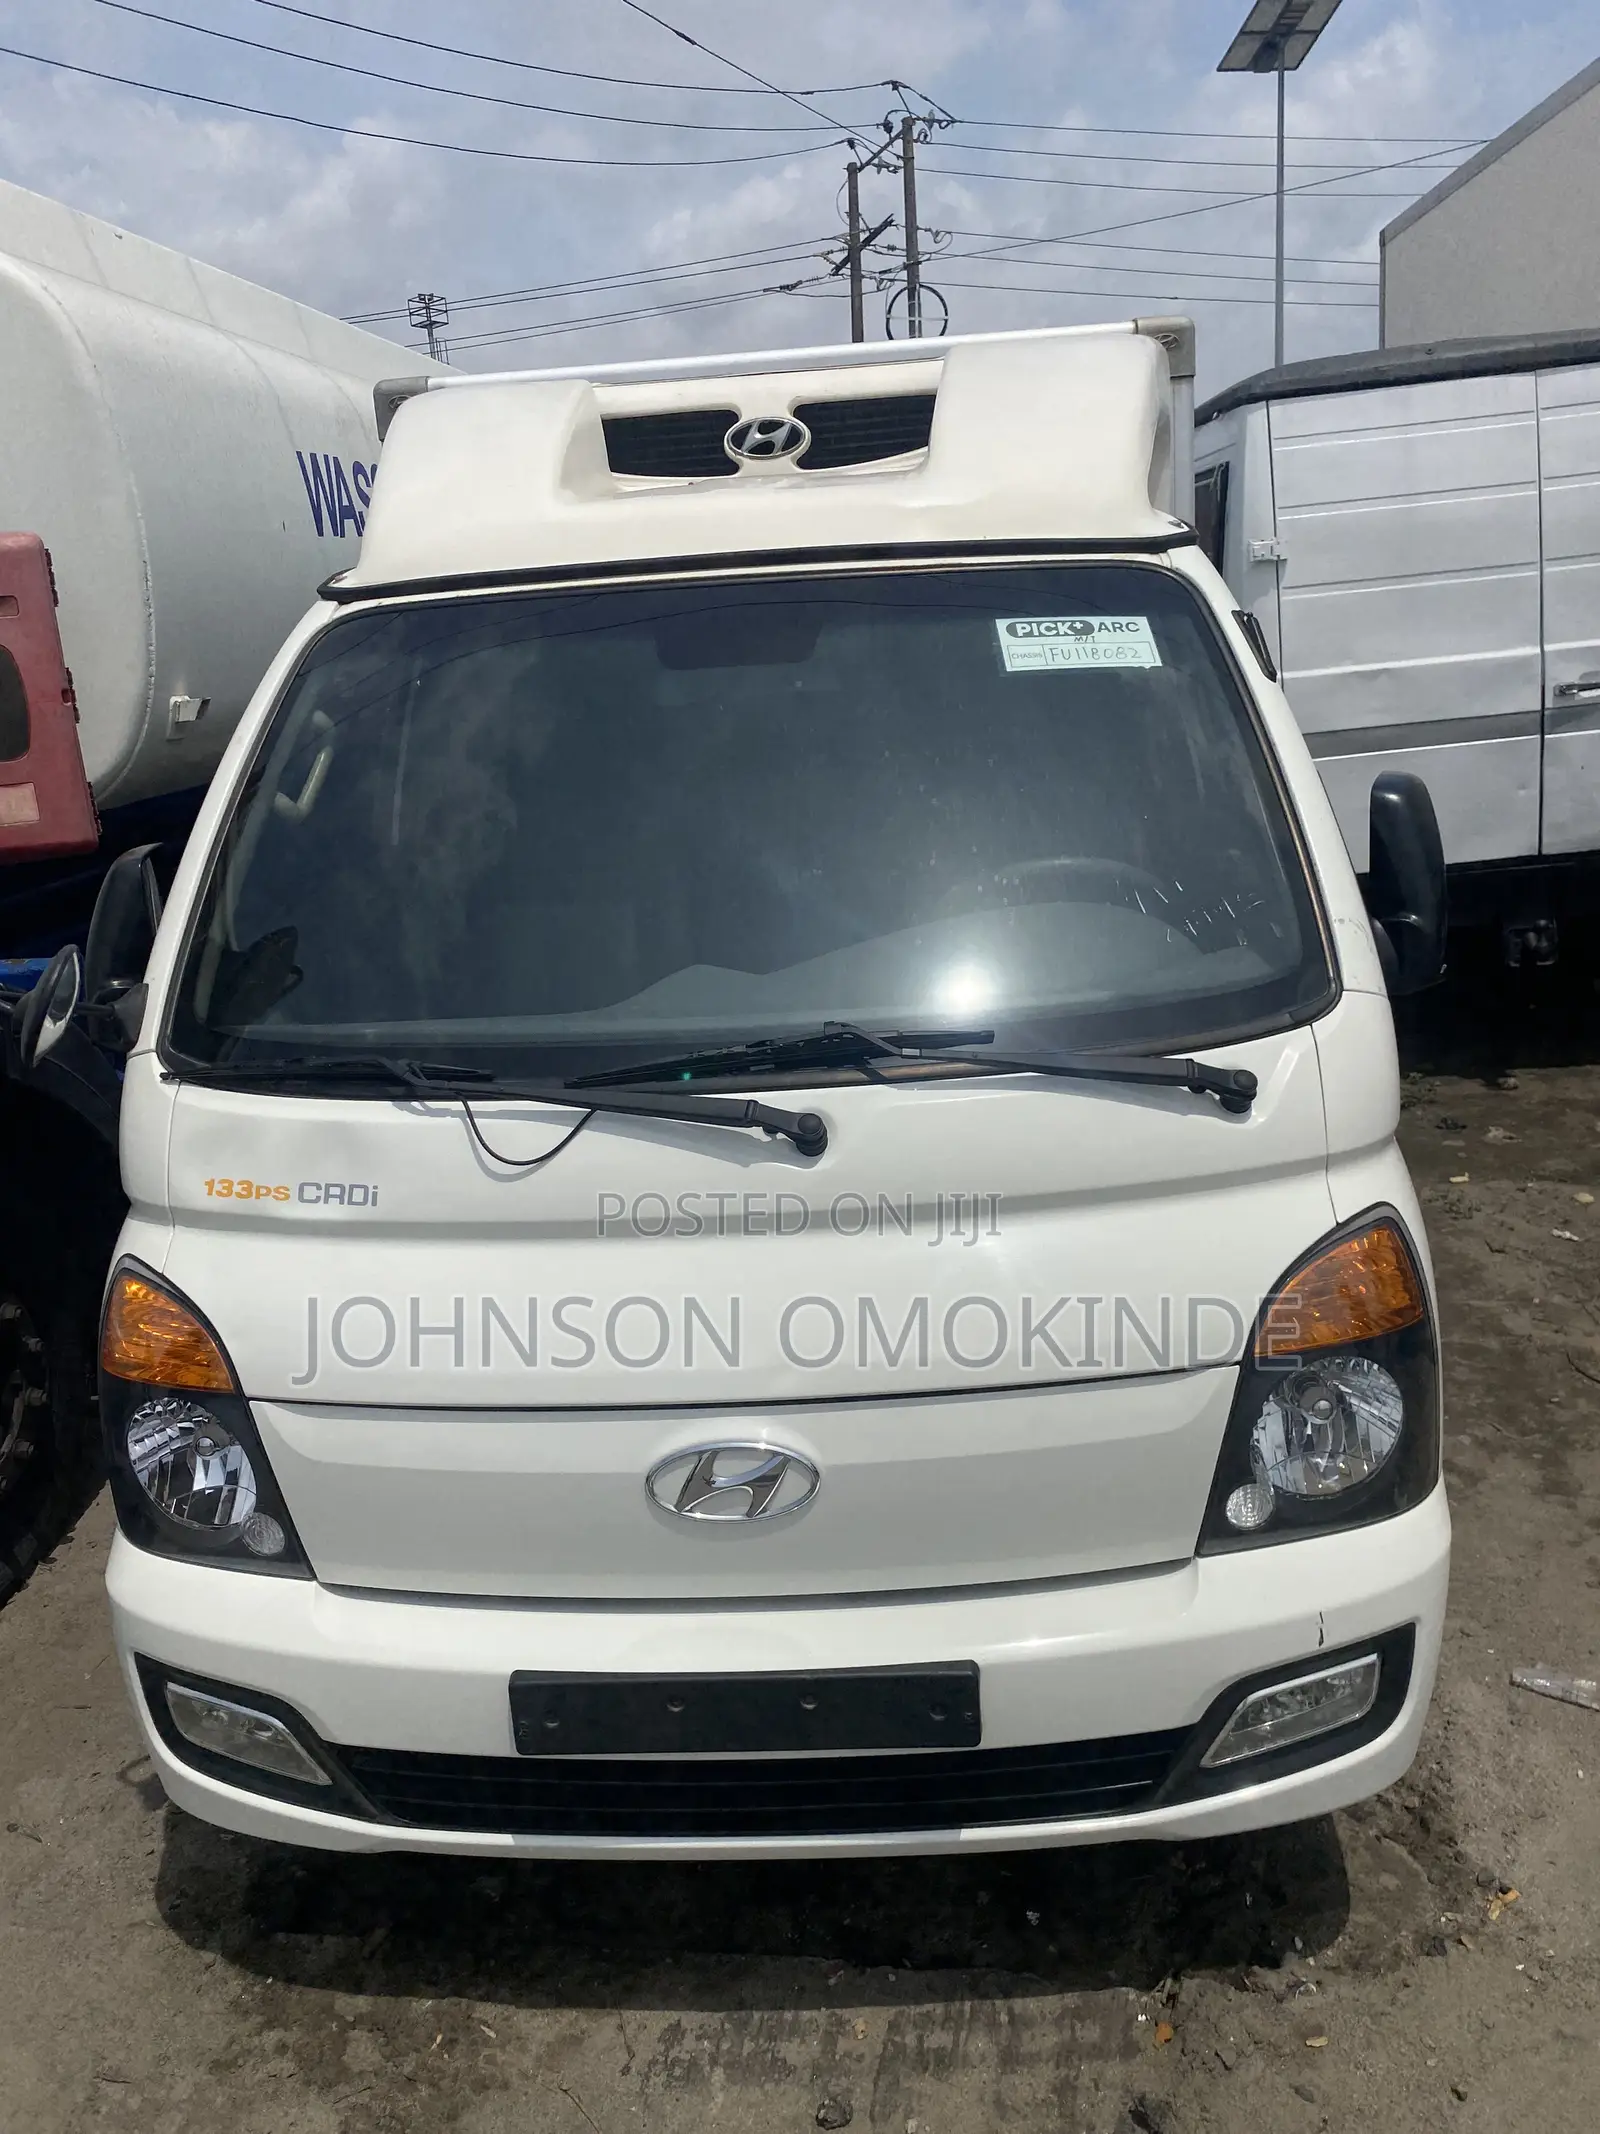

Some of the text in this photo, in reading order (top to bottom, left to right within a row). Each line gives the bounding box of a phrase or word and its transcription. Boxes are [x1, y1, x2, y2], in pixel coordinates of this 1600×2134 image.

[1097, 621, 1140, 633] ARC
[1011, 652, 1043, 660] CHASSIS
[298, 1182, 379, 1207] CRDi
